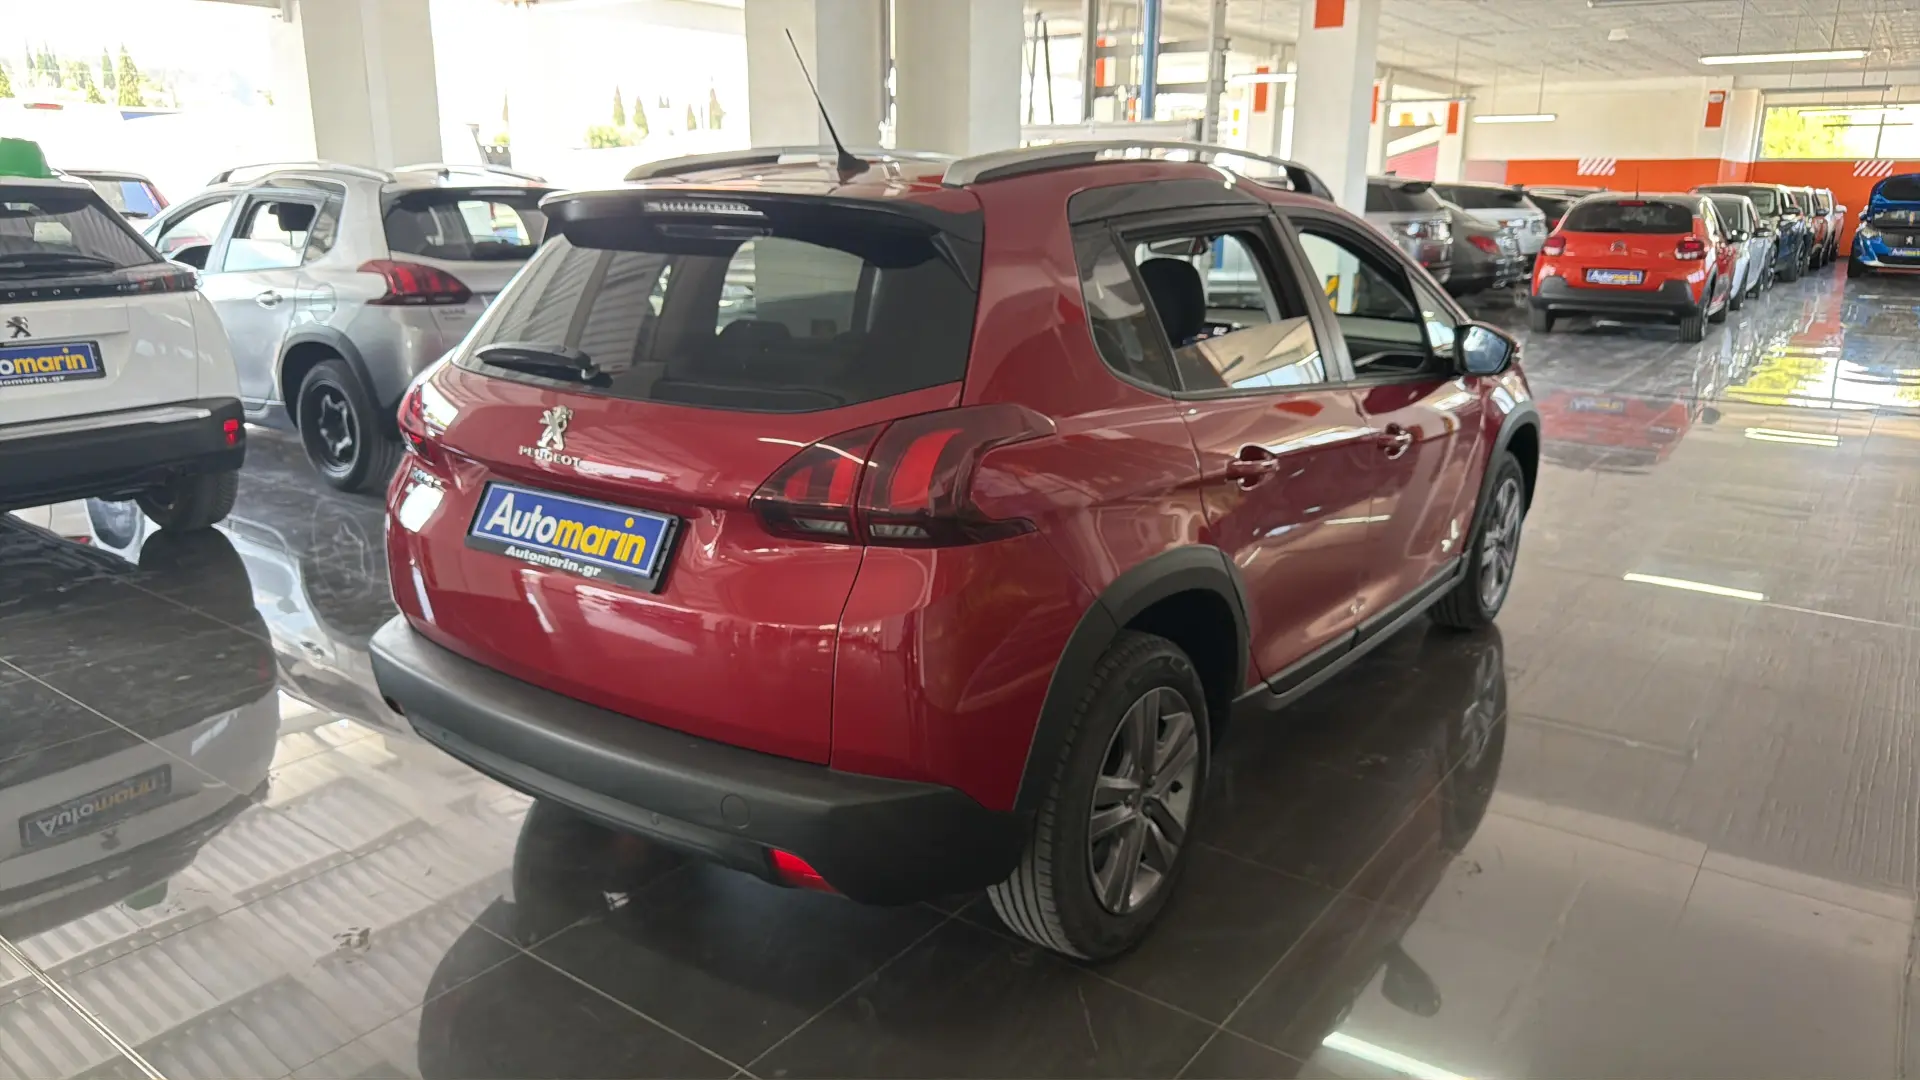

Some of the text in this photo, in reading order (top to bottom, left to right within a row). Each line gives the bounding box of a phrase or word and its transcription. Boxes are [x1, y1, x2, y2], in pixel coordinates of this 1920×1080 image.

[518, 445, 582, 468] PEUGEOT
[484, 492, 647, 565] Automarin
[504, 544, 602, 578] Automarin.gr
